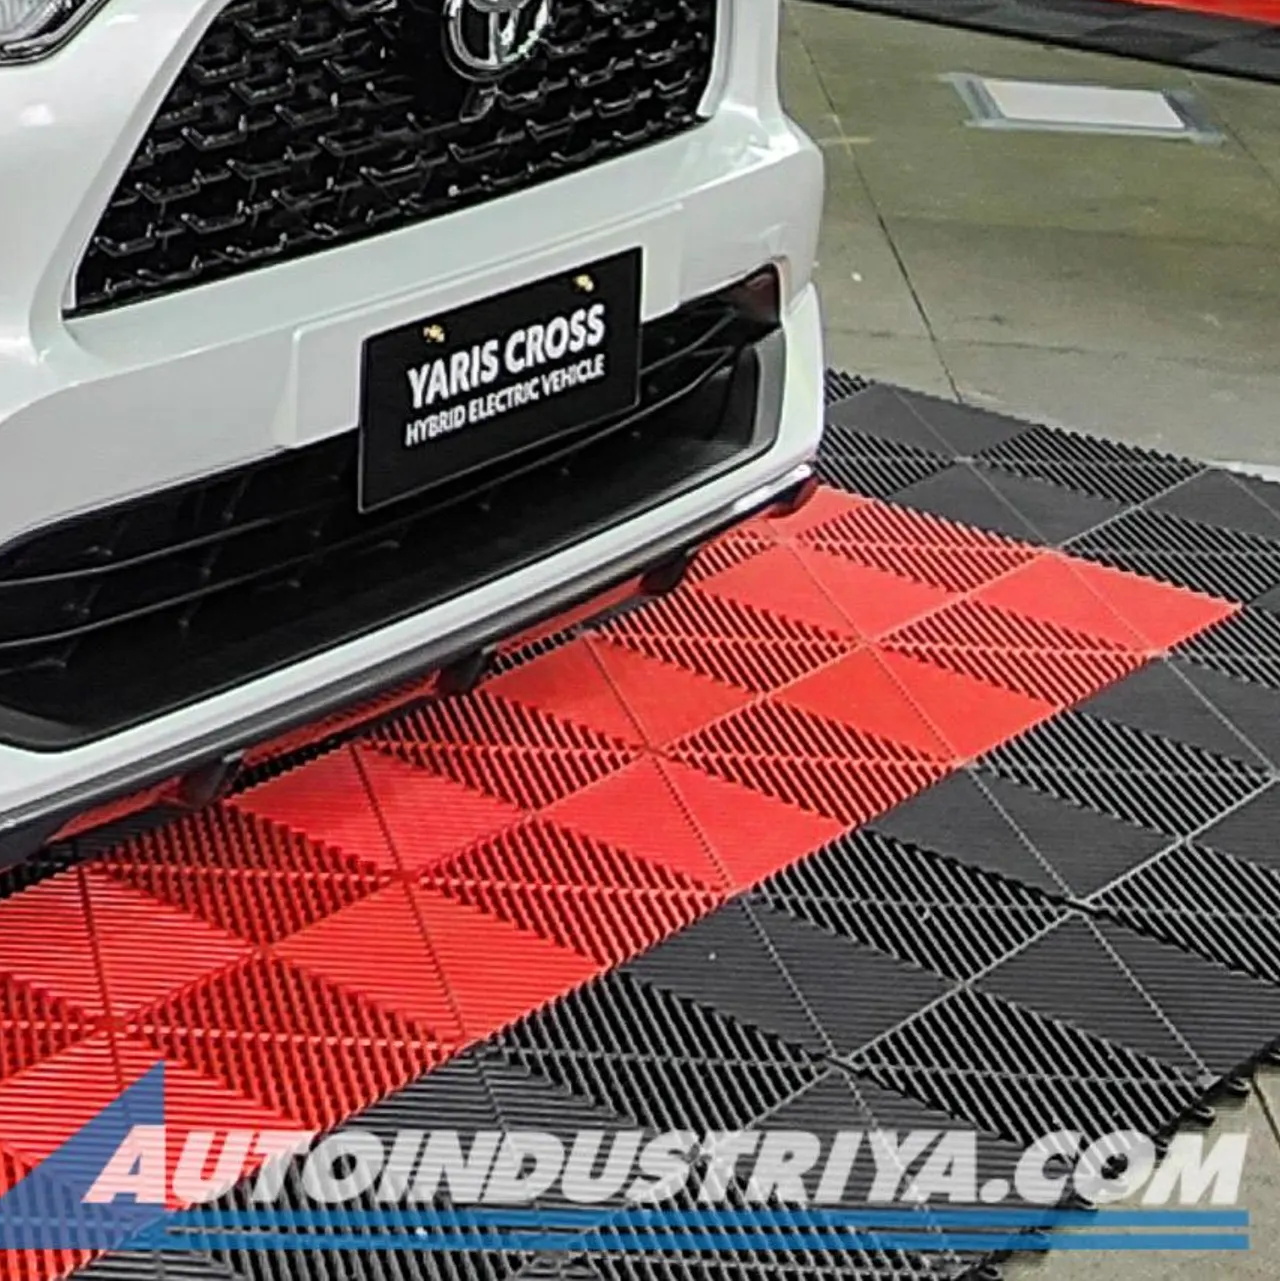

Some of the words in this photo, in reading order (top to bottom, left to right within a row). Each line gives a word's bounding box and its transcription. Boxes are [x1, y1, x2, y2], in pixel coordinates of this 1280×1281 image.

[404, 403, 467, 447] HYBRID
[468, 376, 540, 423] ELECTRIC
[540, 353, 606, 397] VEHICLE
[406, 339, 500, 409] YARIS
[503, 303, 606, 374] CROSS
